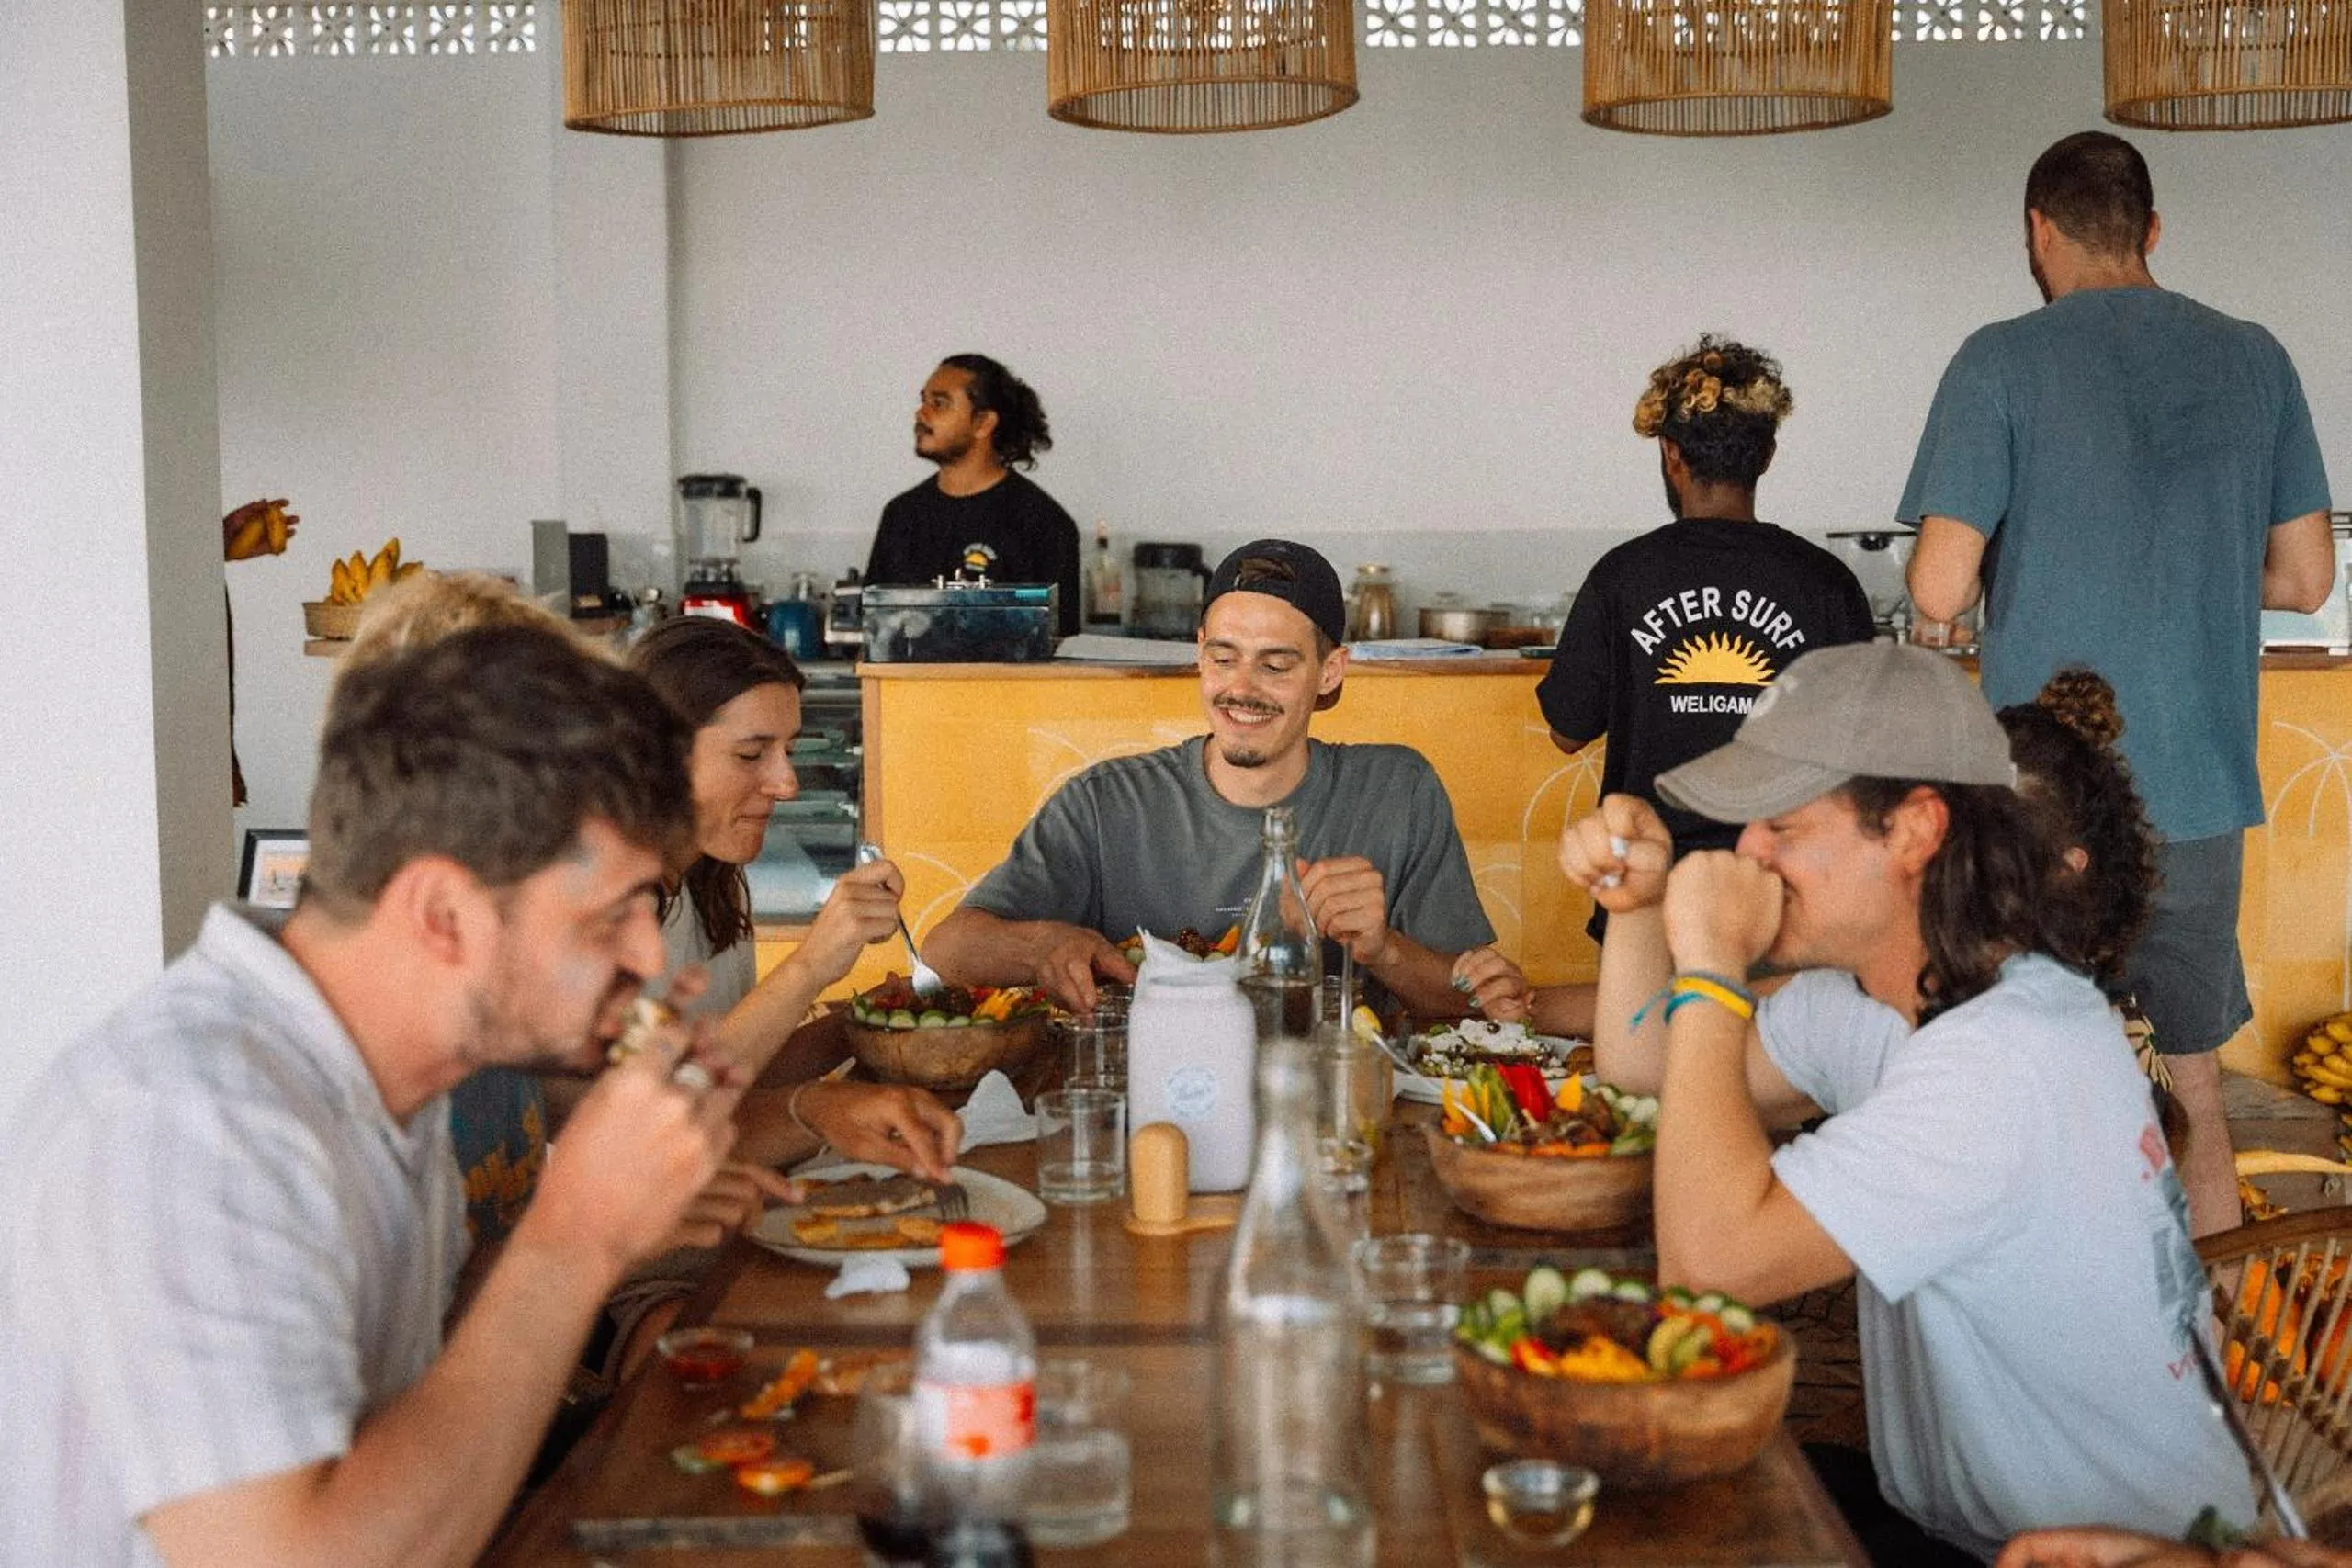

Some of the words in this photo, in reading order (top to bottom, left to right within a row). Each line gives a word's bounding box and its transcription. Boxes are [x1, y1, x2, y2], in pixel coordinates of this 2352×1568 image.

[1631, 587, 1723, 656] AFTER
[1731, 589, 1806, 650] SURF
[1670, 695, 1753, 714] WELIGAM
